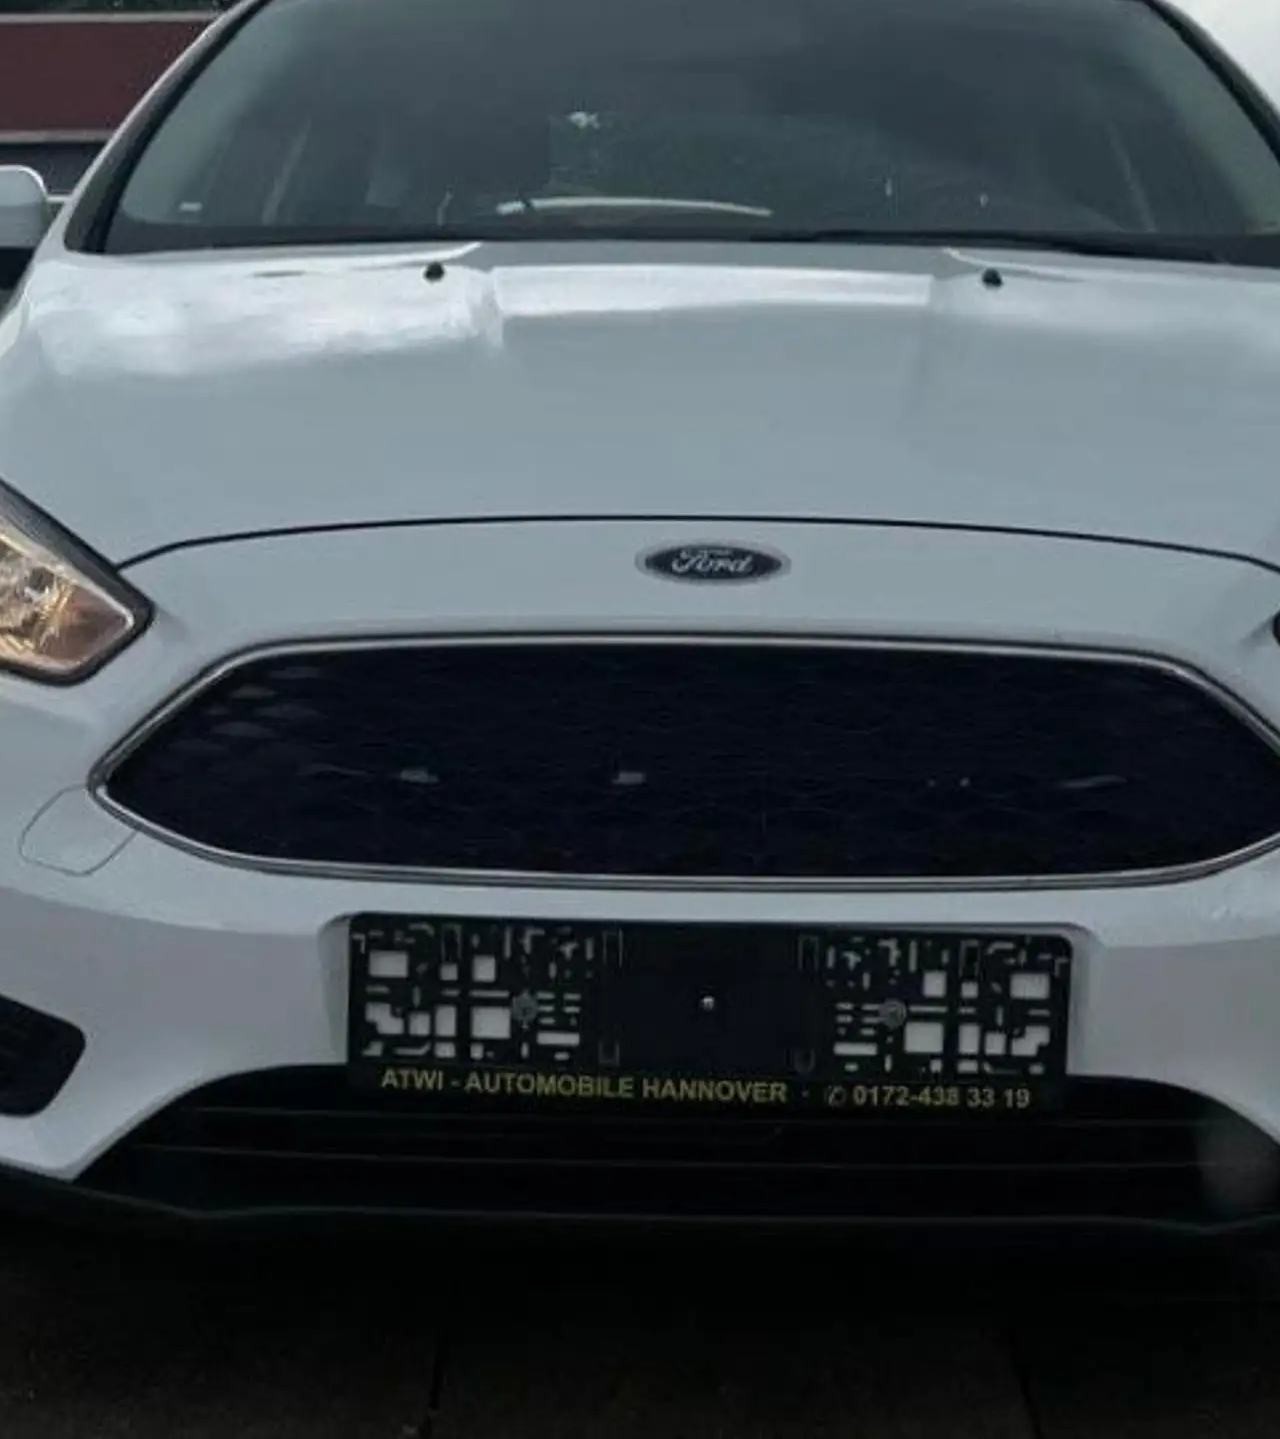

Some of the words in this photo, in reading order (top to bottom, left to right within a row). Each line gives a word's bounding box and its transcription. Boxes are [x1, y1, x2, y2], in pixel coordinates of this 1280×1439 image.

[671, 549, 753, 574] Ford
[380, 1067, 444, 1091] ATWI
[464, 1071, 635, 1099] AUTOMOBILE
[641, 1077, 788, 1103] HANNOVER
[852, 1084, 960, 1107] 0172-438
[966, 1086, 996, 1108] 33
[1003, 1087, 1031, 1109] 19
